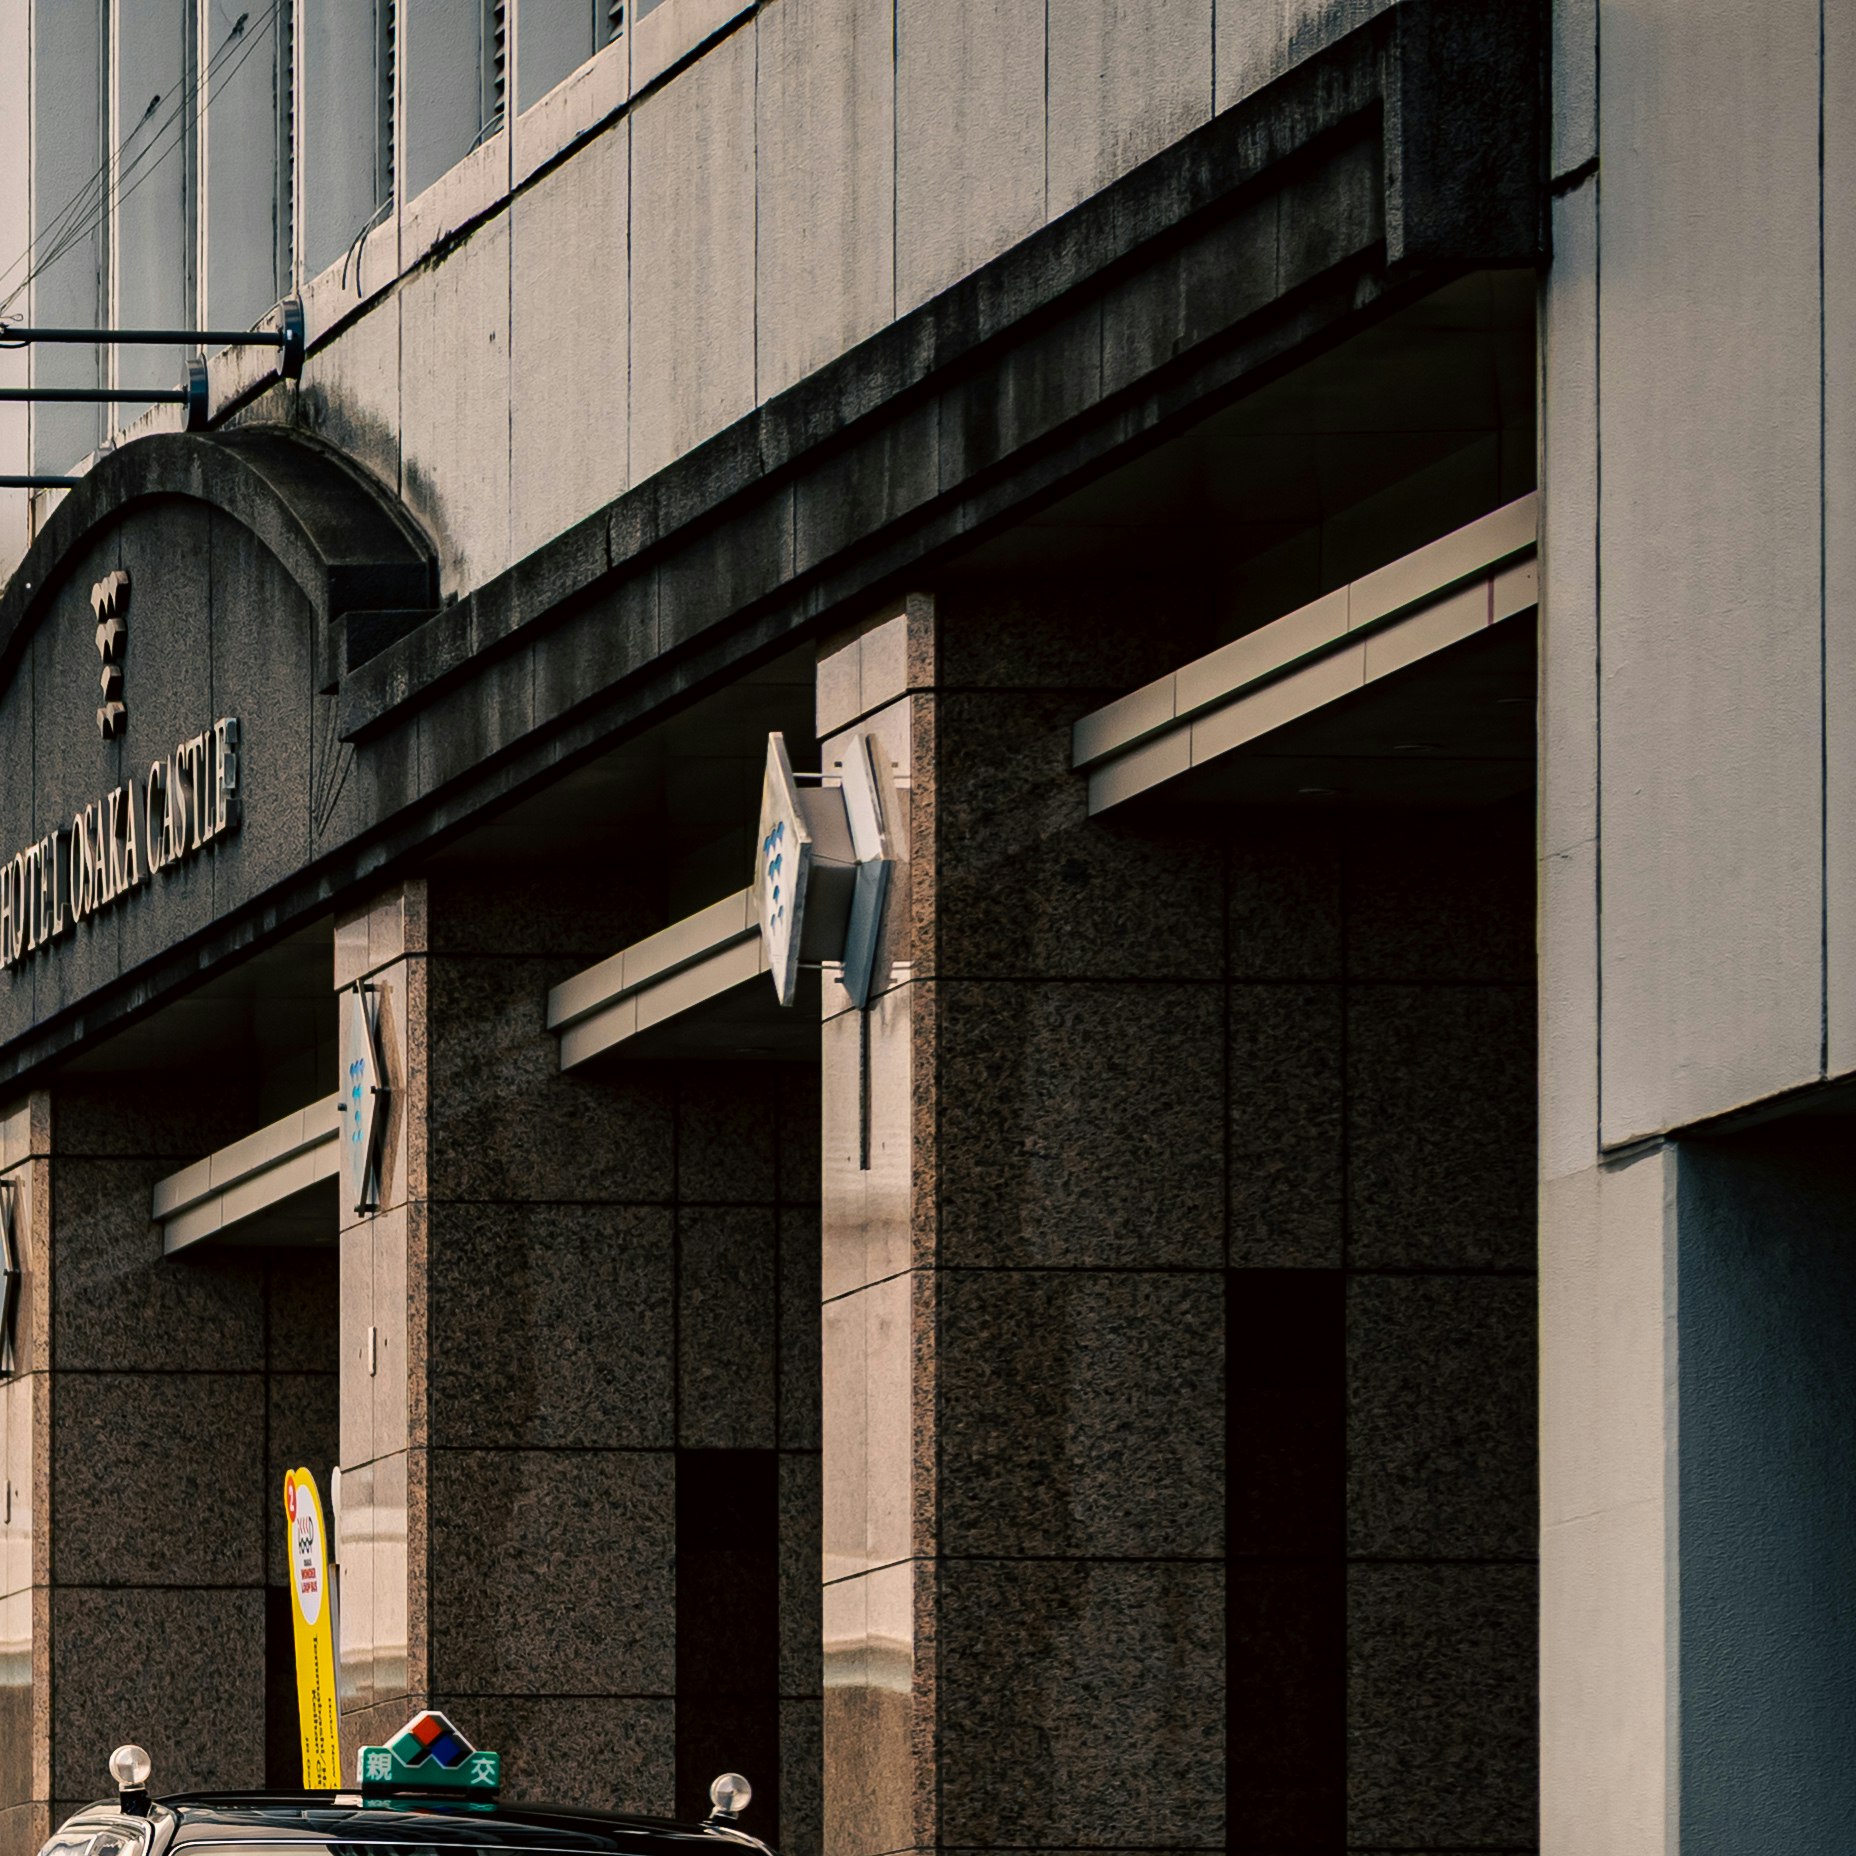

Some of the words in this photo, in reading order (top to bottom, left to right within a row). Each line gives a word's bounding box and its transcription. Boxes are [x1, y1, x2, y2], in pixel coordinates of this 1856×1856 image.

[0, 830, 68, 970] HOTEL
[70, 778, 140, 924] OSAKA
[146, 717, 239, 876] CASTLE
[288, 1485, 295, 1512] 2
[366, 1752, 393, 1781] 親
[470, 1757, 496, 1786] 交
